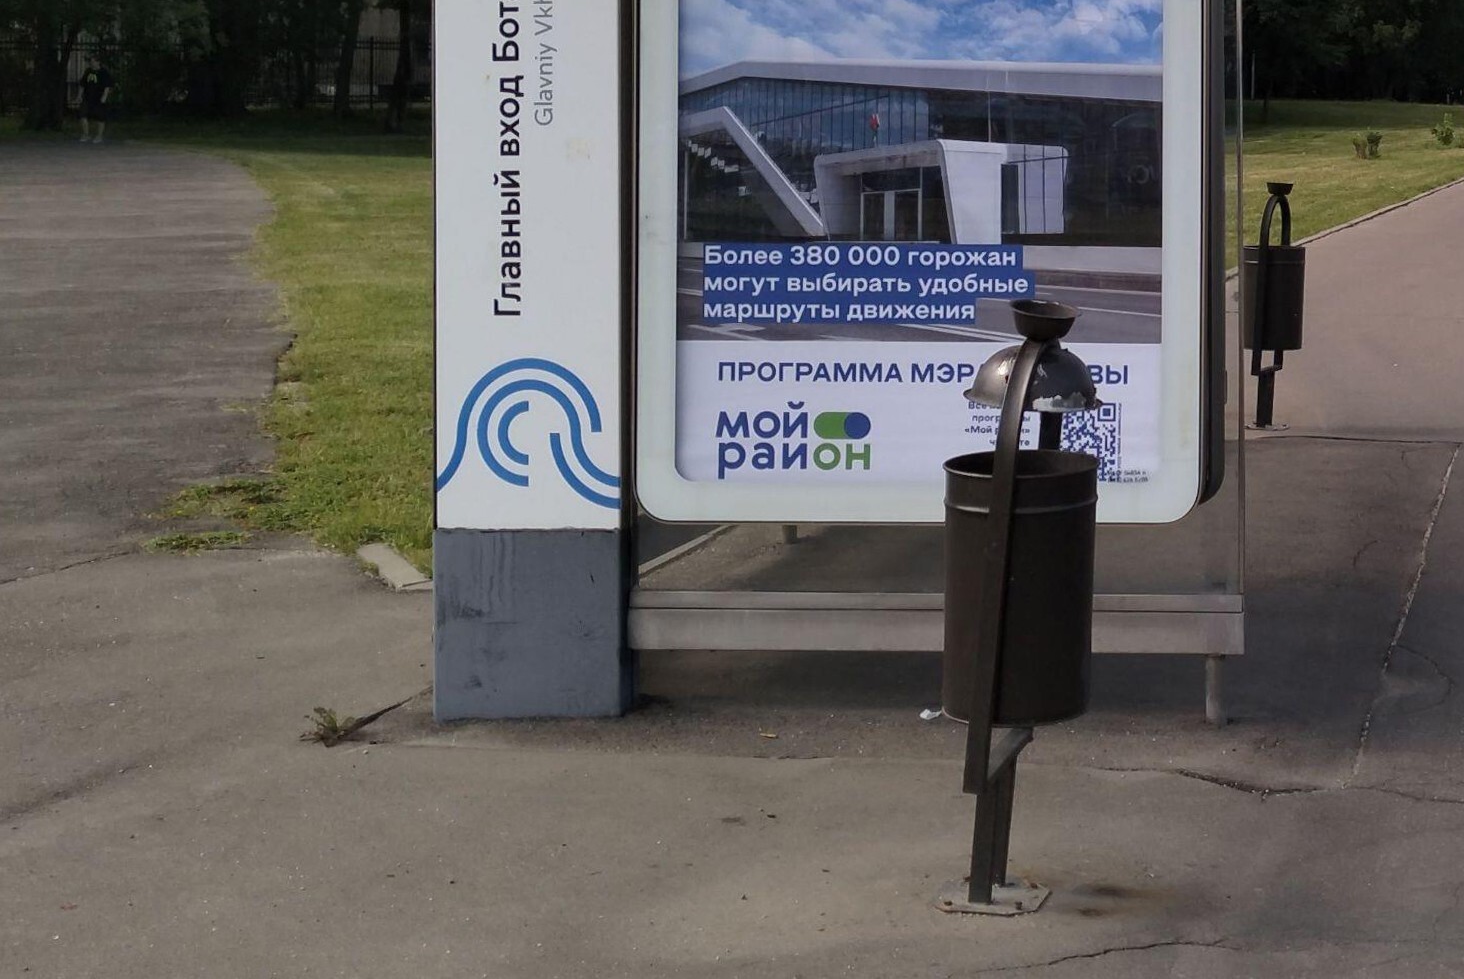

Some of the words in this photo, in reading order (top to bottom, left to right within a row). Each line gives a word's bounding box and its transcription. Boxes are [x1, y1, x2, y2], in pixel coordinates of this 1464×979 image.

[533, 42, 558, 126] Glavniy
[499, 75, 525, 156] вход
[494, 170, 522, 316] Главный
[705, 246, 783, 265] Более
[790, 246, 840, 265] 380
[848, 246, 900, 265] 000
[908, 249, 1017, 270] горожан
[704, 275, 779, 296] могут
[788, 273, 911, 297] выбирать
[919, 273, 1028, 297] удобные
[704, 301, 840, 323] маршруты
[847, 302, 975, 321] движения
[718, 362, 904, 383] ПРОГРАММА
[911, 362, 975, 384] МЭР
[715, 401, 809, 439] мой
